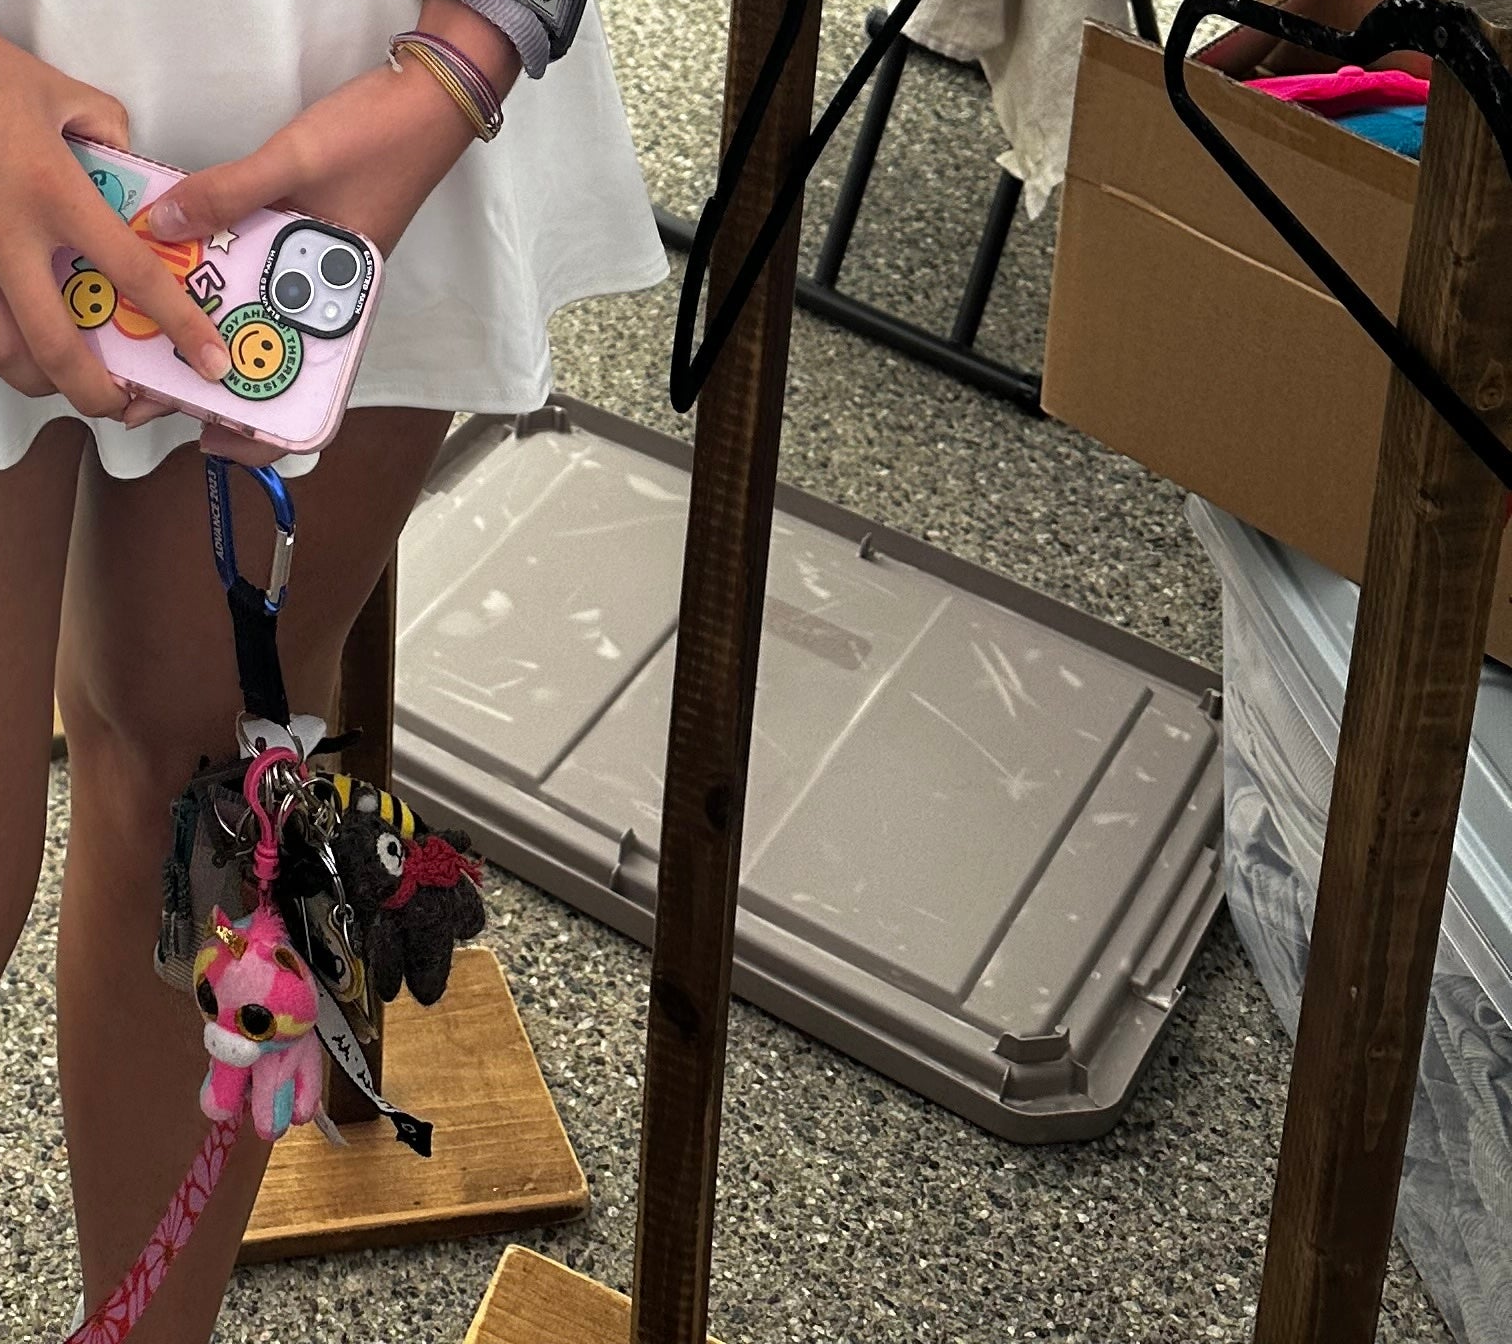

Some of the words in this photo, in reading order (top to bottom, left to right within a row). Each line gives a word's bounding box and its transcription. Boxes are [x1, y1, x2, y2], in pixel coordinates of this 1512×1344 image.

[277, 336, 296, 384] THERE
[241, 382, 261, 393] SO
[263, 380, 278, 392] IS
